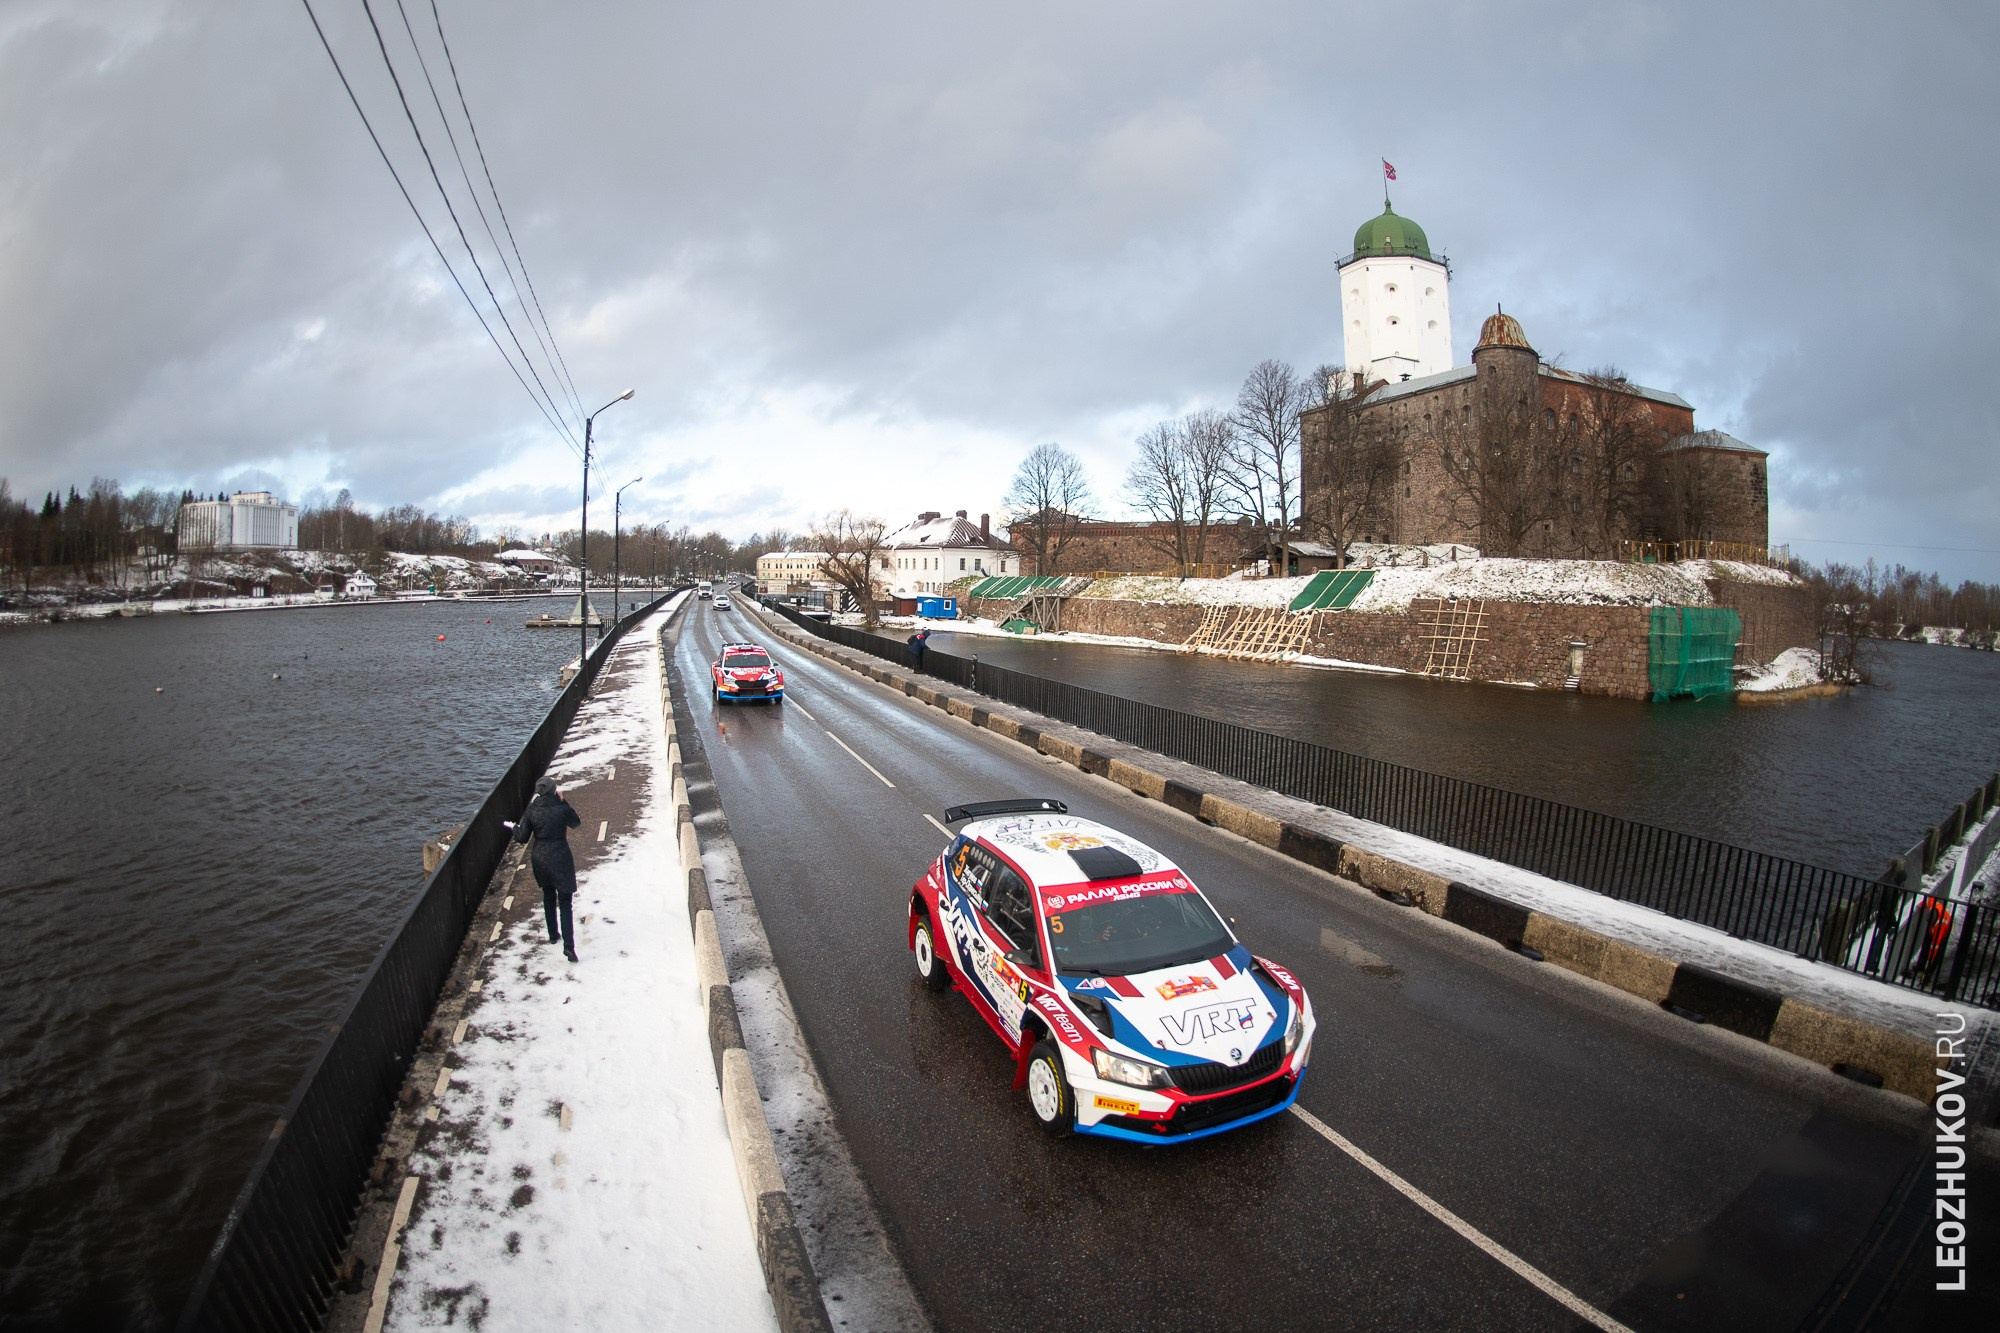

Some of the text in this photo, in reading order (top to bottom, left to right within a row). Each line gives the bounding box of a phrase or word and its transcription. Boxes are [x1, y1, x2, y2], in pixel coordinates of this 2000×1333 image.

[955, 845, 970, 877] 5
[1066, 886, 1119, 904] РАЛЛИ
[1120, 880, 1174, 895] РОССИИ
[946, 896, 974, 956] VRT
[1050, 915, 1064, 934] 5
[1019, 980, 1030, 1003] 5
[1271, 969, 1300, 990] VRT
[1035, 993, 1066, 1012] VRT
[1052, 1012, 1083, 1043] team
[1159, 997, 1257, 1046] VRT
[1097, 1098, 1136, 1112] PIRELLI
